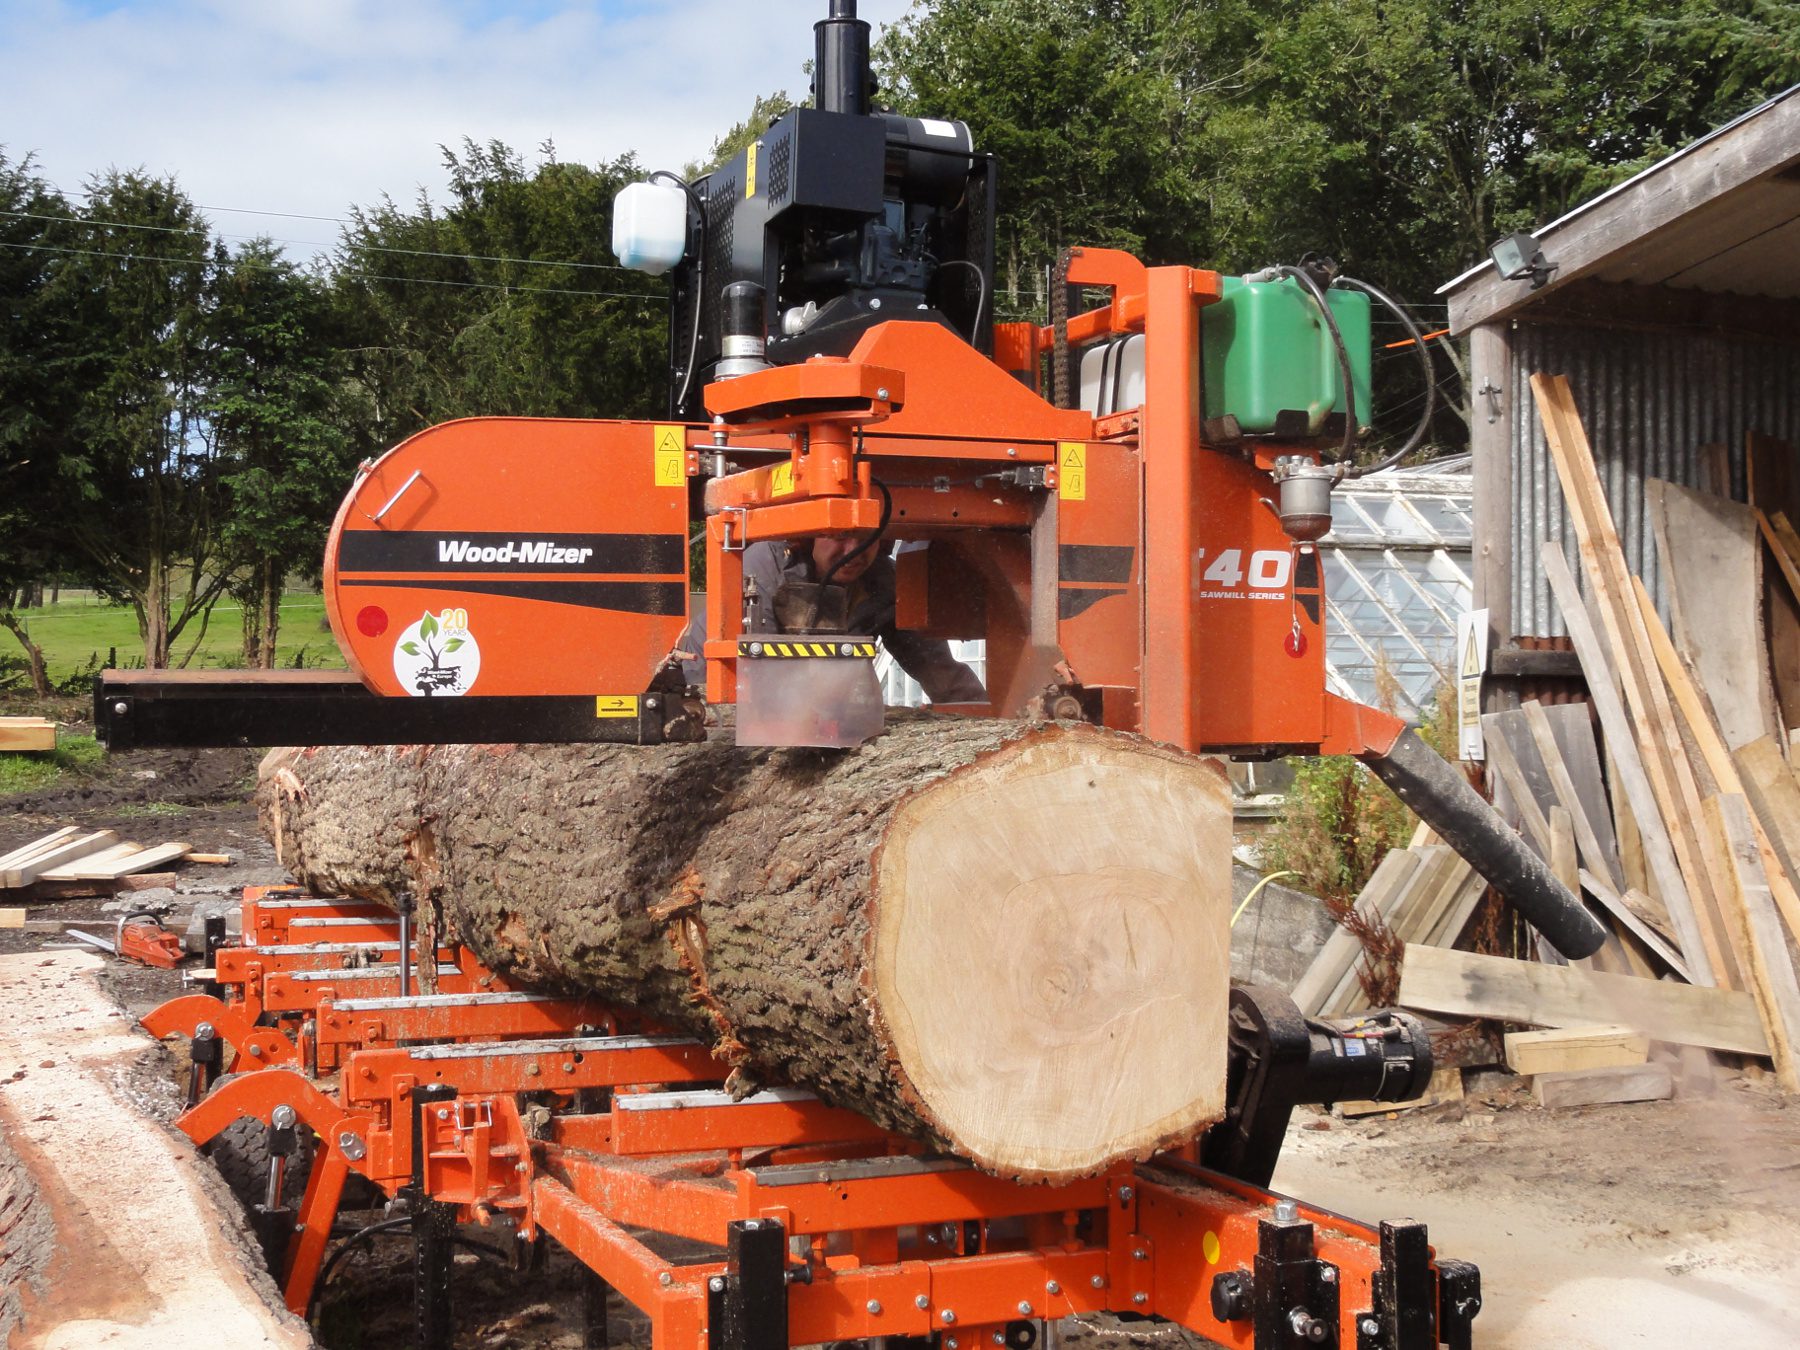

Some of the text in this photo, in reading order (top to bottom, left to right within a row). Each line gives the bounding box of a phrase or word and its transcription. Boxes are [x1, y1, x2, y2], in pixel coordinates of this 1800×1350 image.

[438, 540, 593, 563] Wood-Mizer
[1199, 547, 1292, 588] 40
[1200, 591, 1285, 600] SAWMILL SERIES
[442, 608, 467, 630] 20
